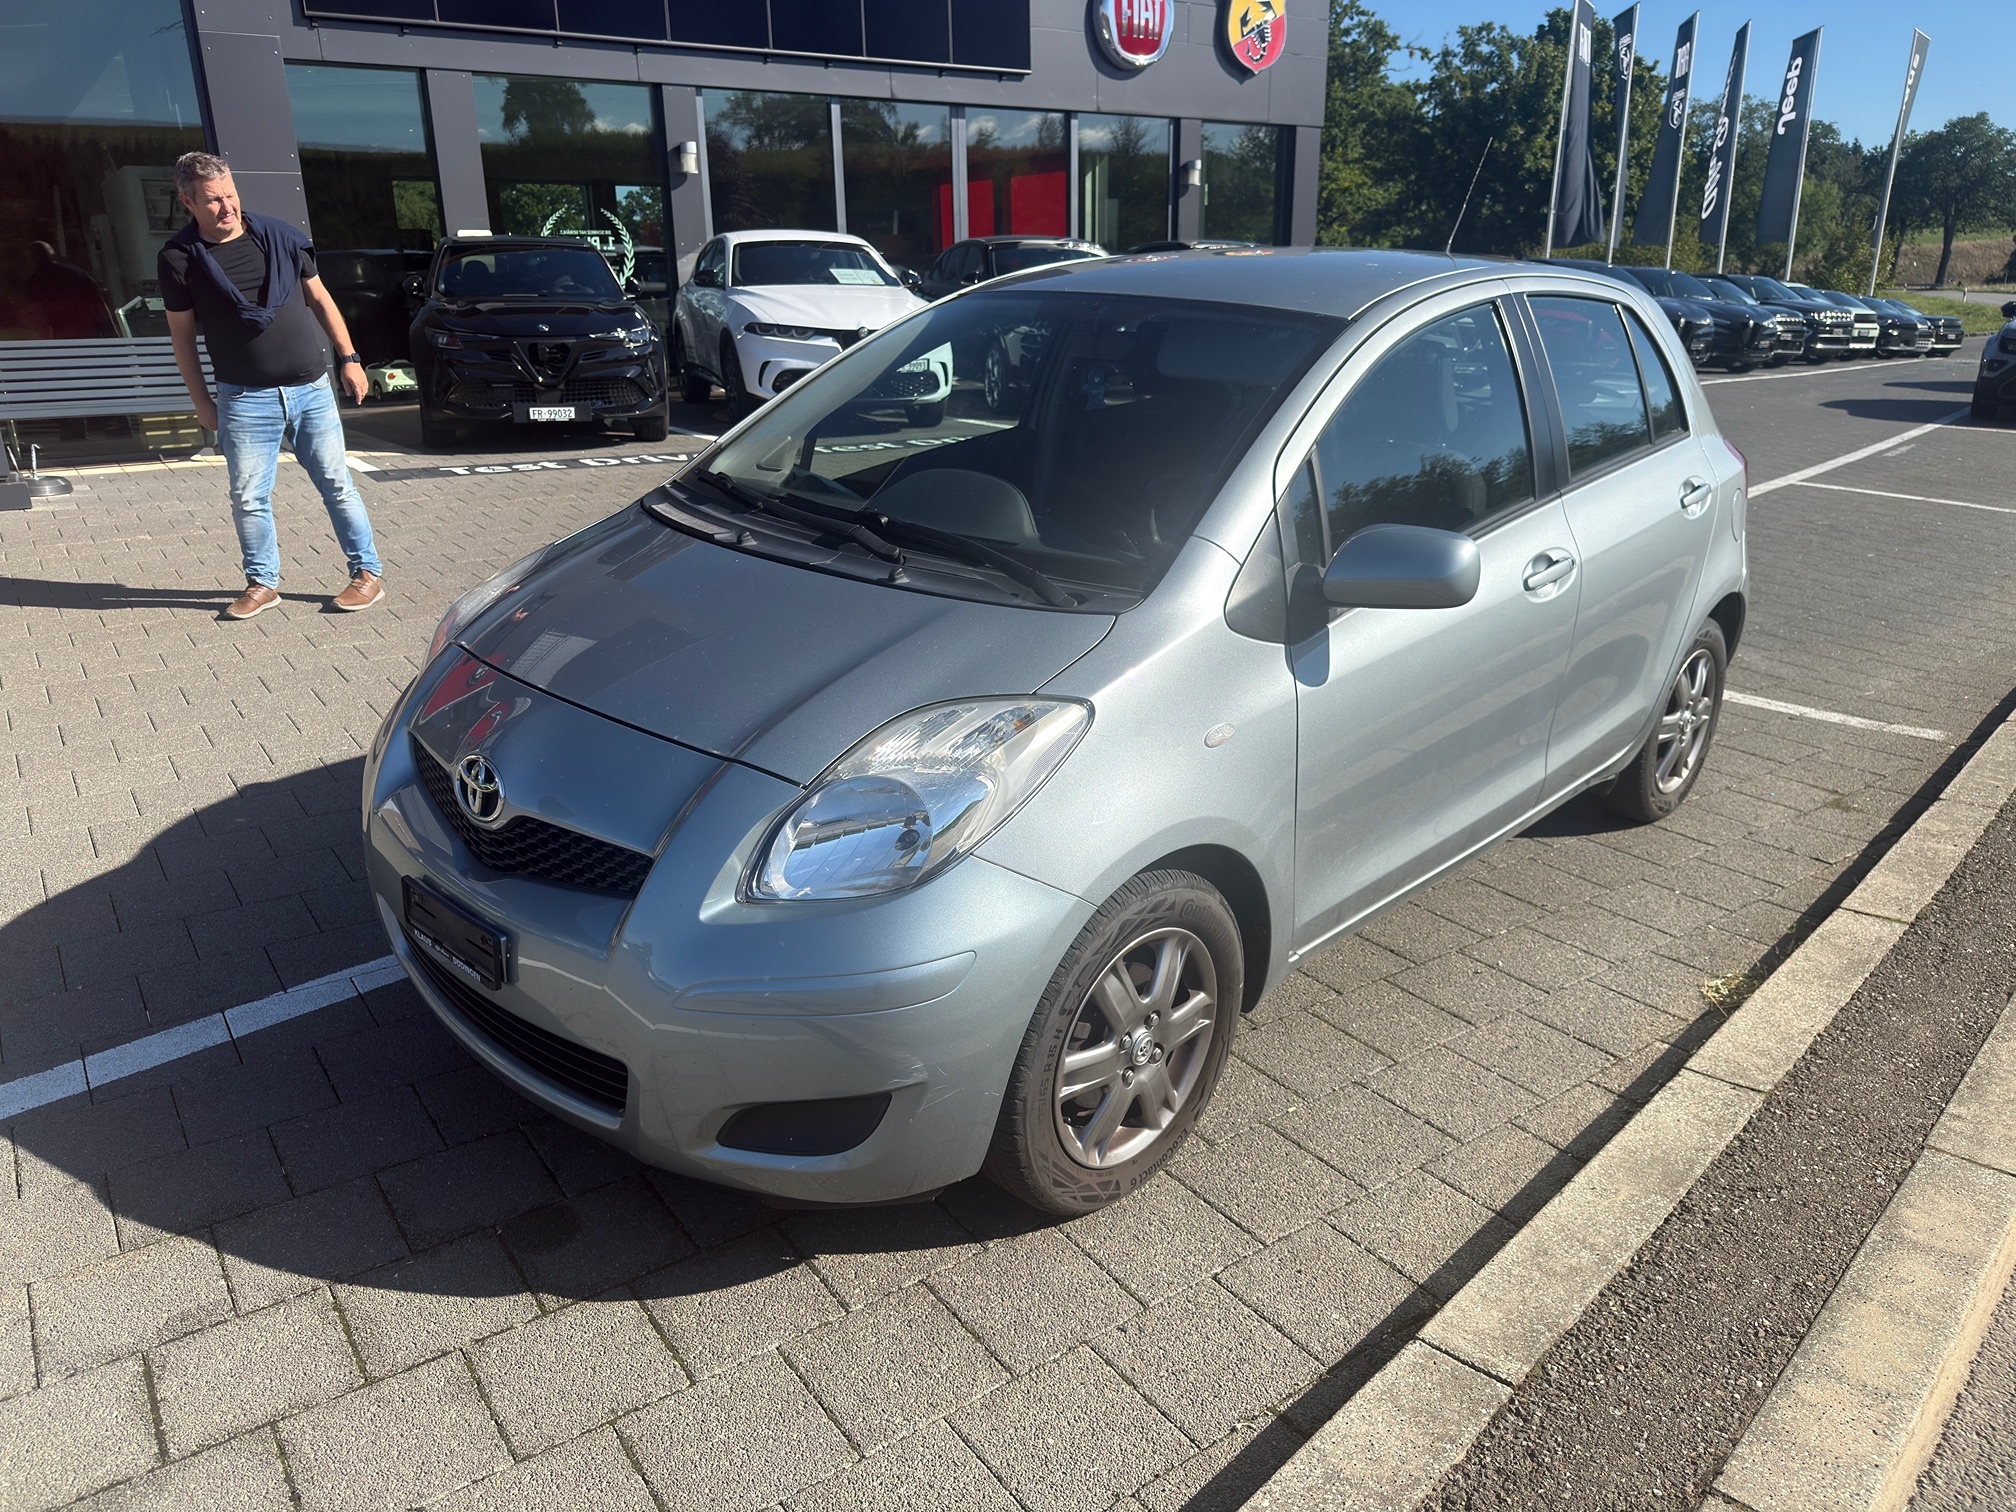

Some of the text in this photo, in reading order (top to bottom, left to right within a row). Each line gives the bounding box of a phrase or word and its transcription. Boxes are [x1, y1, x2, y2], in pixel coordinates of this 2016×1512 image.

[1121, 0, 1161, 40] FIAT
[438, 453, 699, 475] Test Driv
[1053, 1028, 1063, 1040] H
[1129, 1127, 1188, 1190] EcoContact 6
